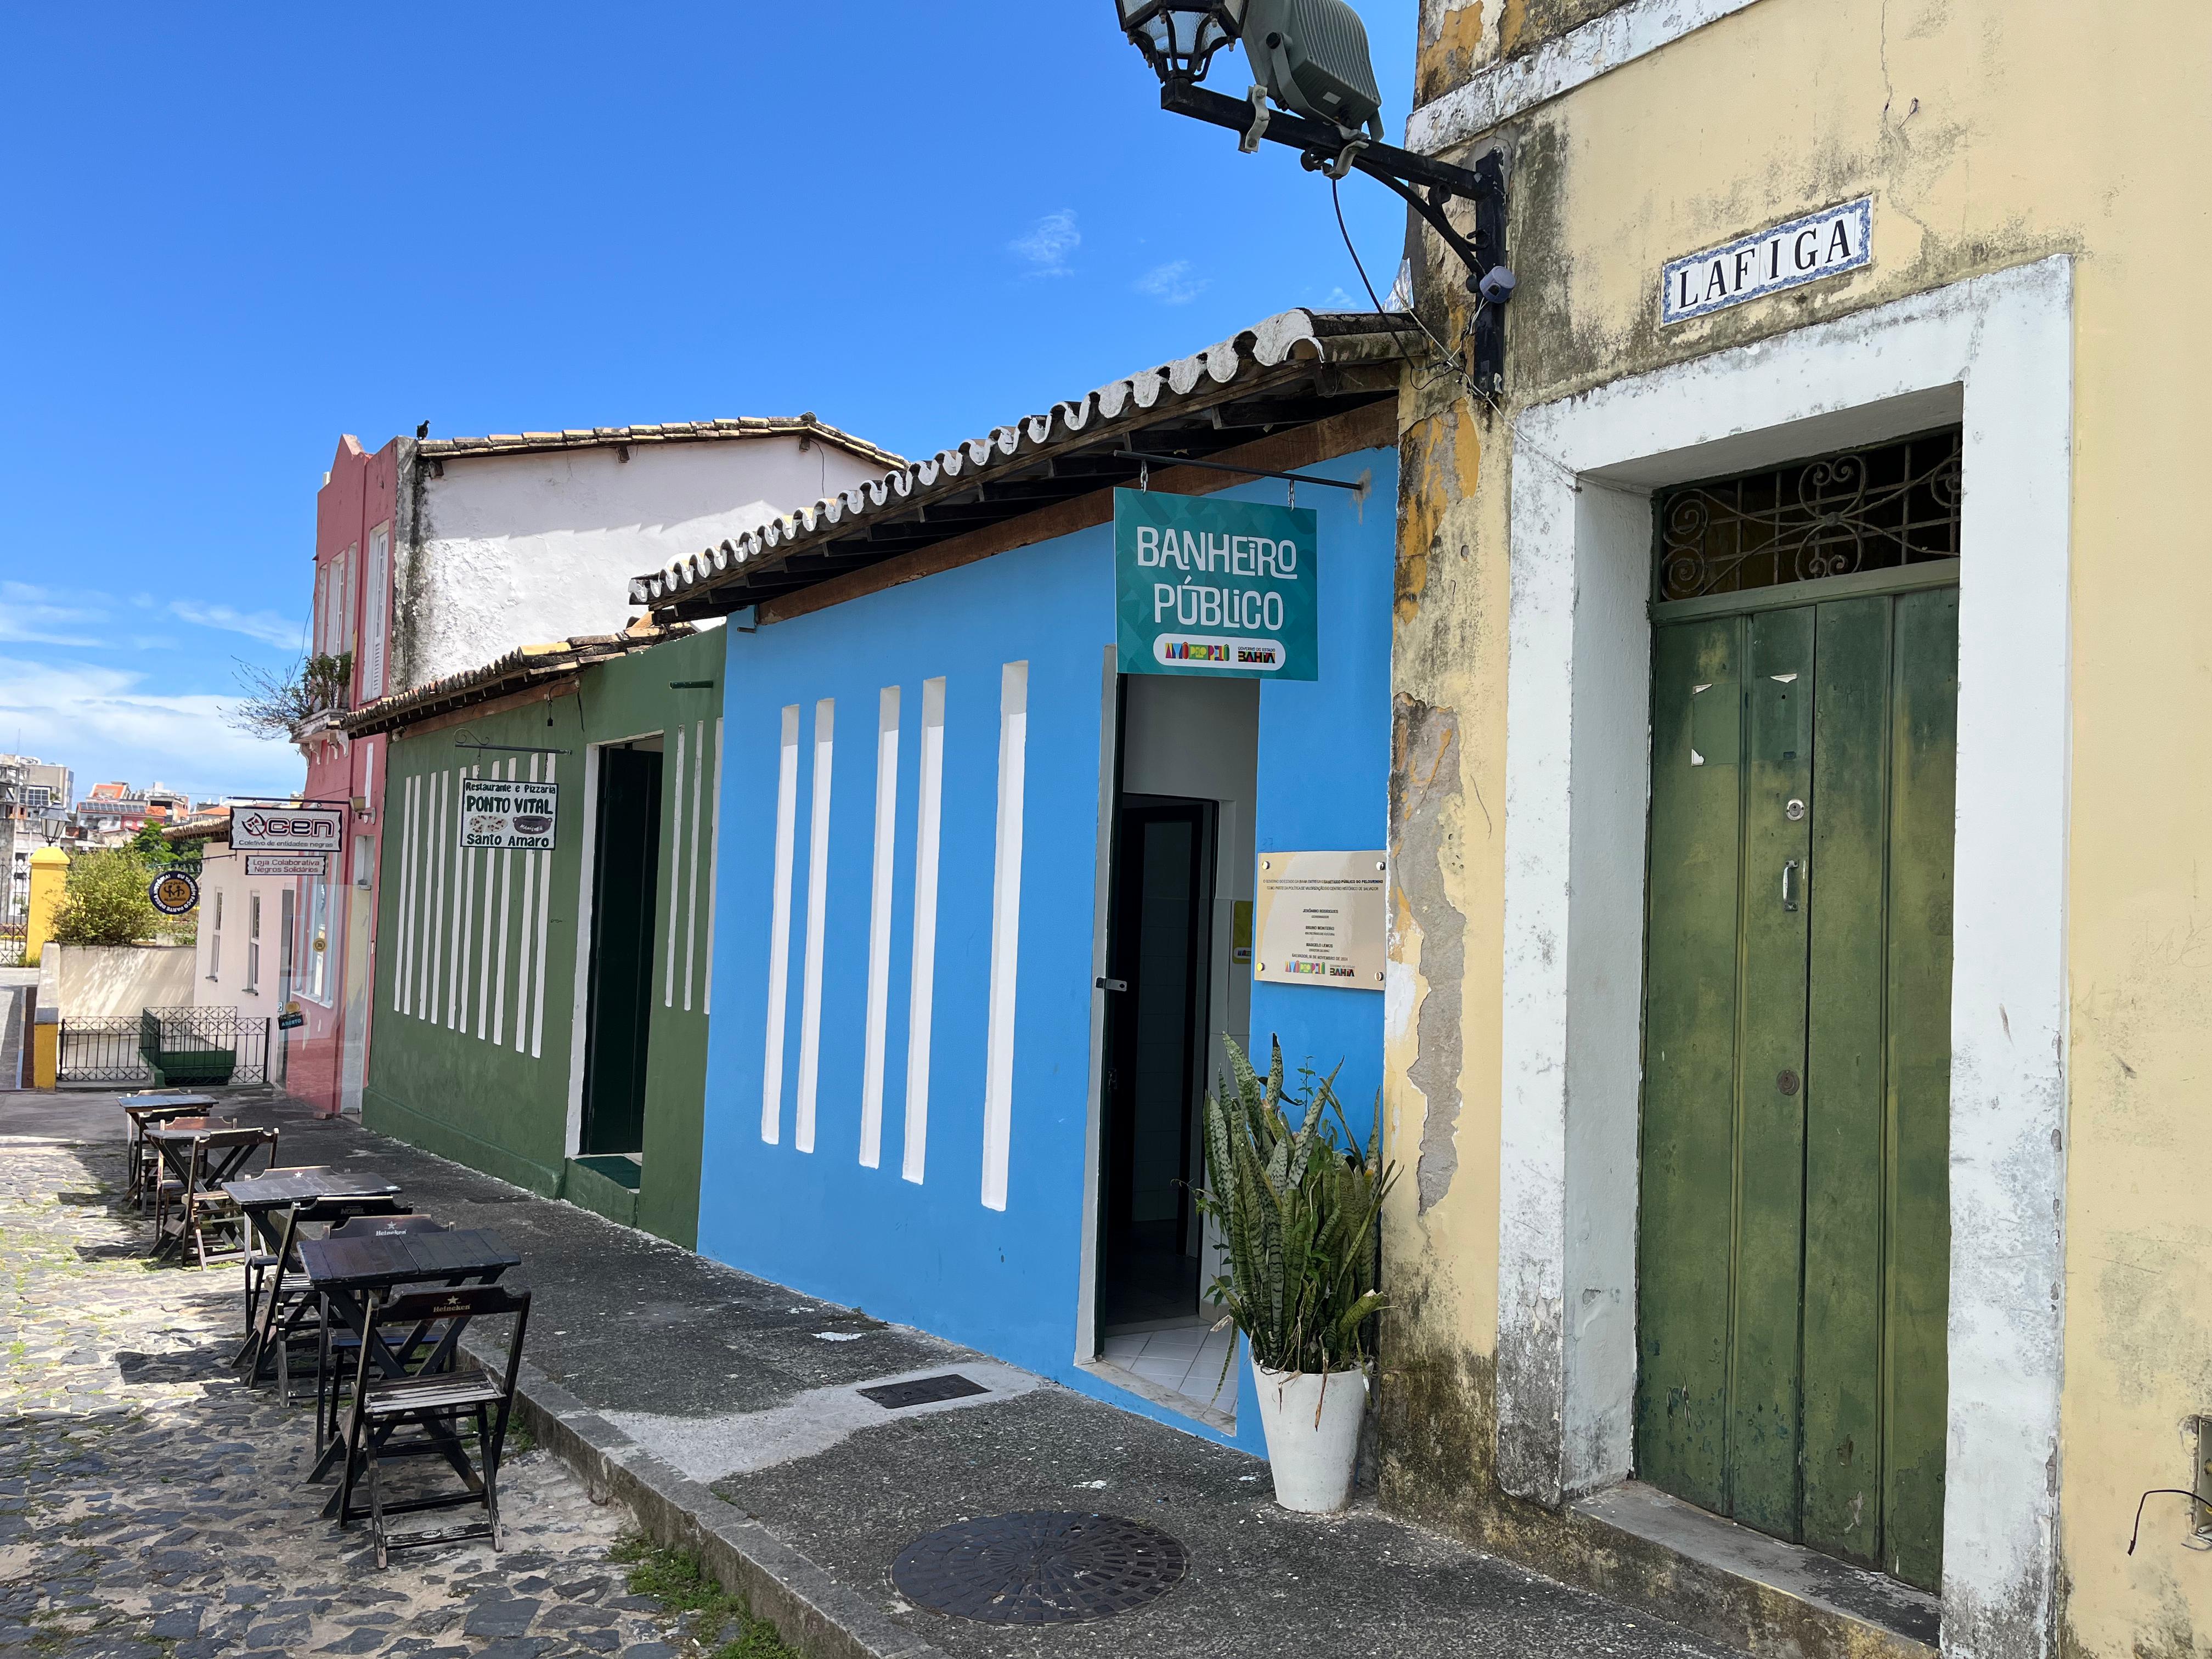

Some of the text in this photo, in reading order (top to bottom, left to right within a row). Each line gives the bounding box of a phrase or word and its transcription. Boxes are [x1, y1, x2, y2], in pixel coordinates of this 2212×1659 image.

[466, 782, 511, 792] Restaurante
[524, 784, 556, 794] Pizzaria
[466, 795, 554, 814] PONTO VITAL
[467, 833, 549, 847] Santo Amaro
[433, 1305, 470, 1313] Heineken
